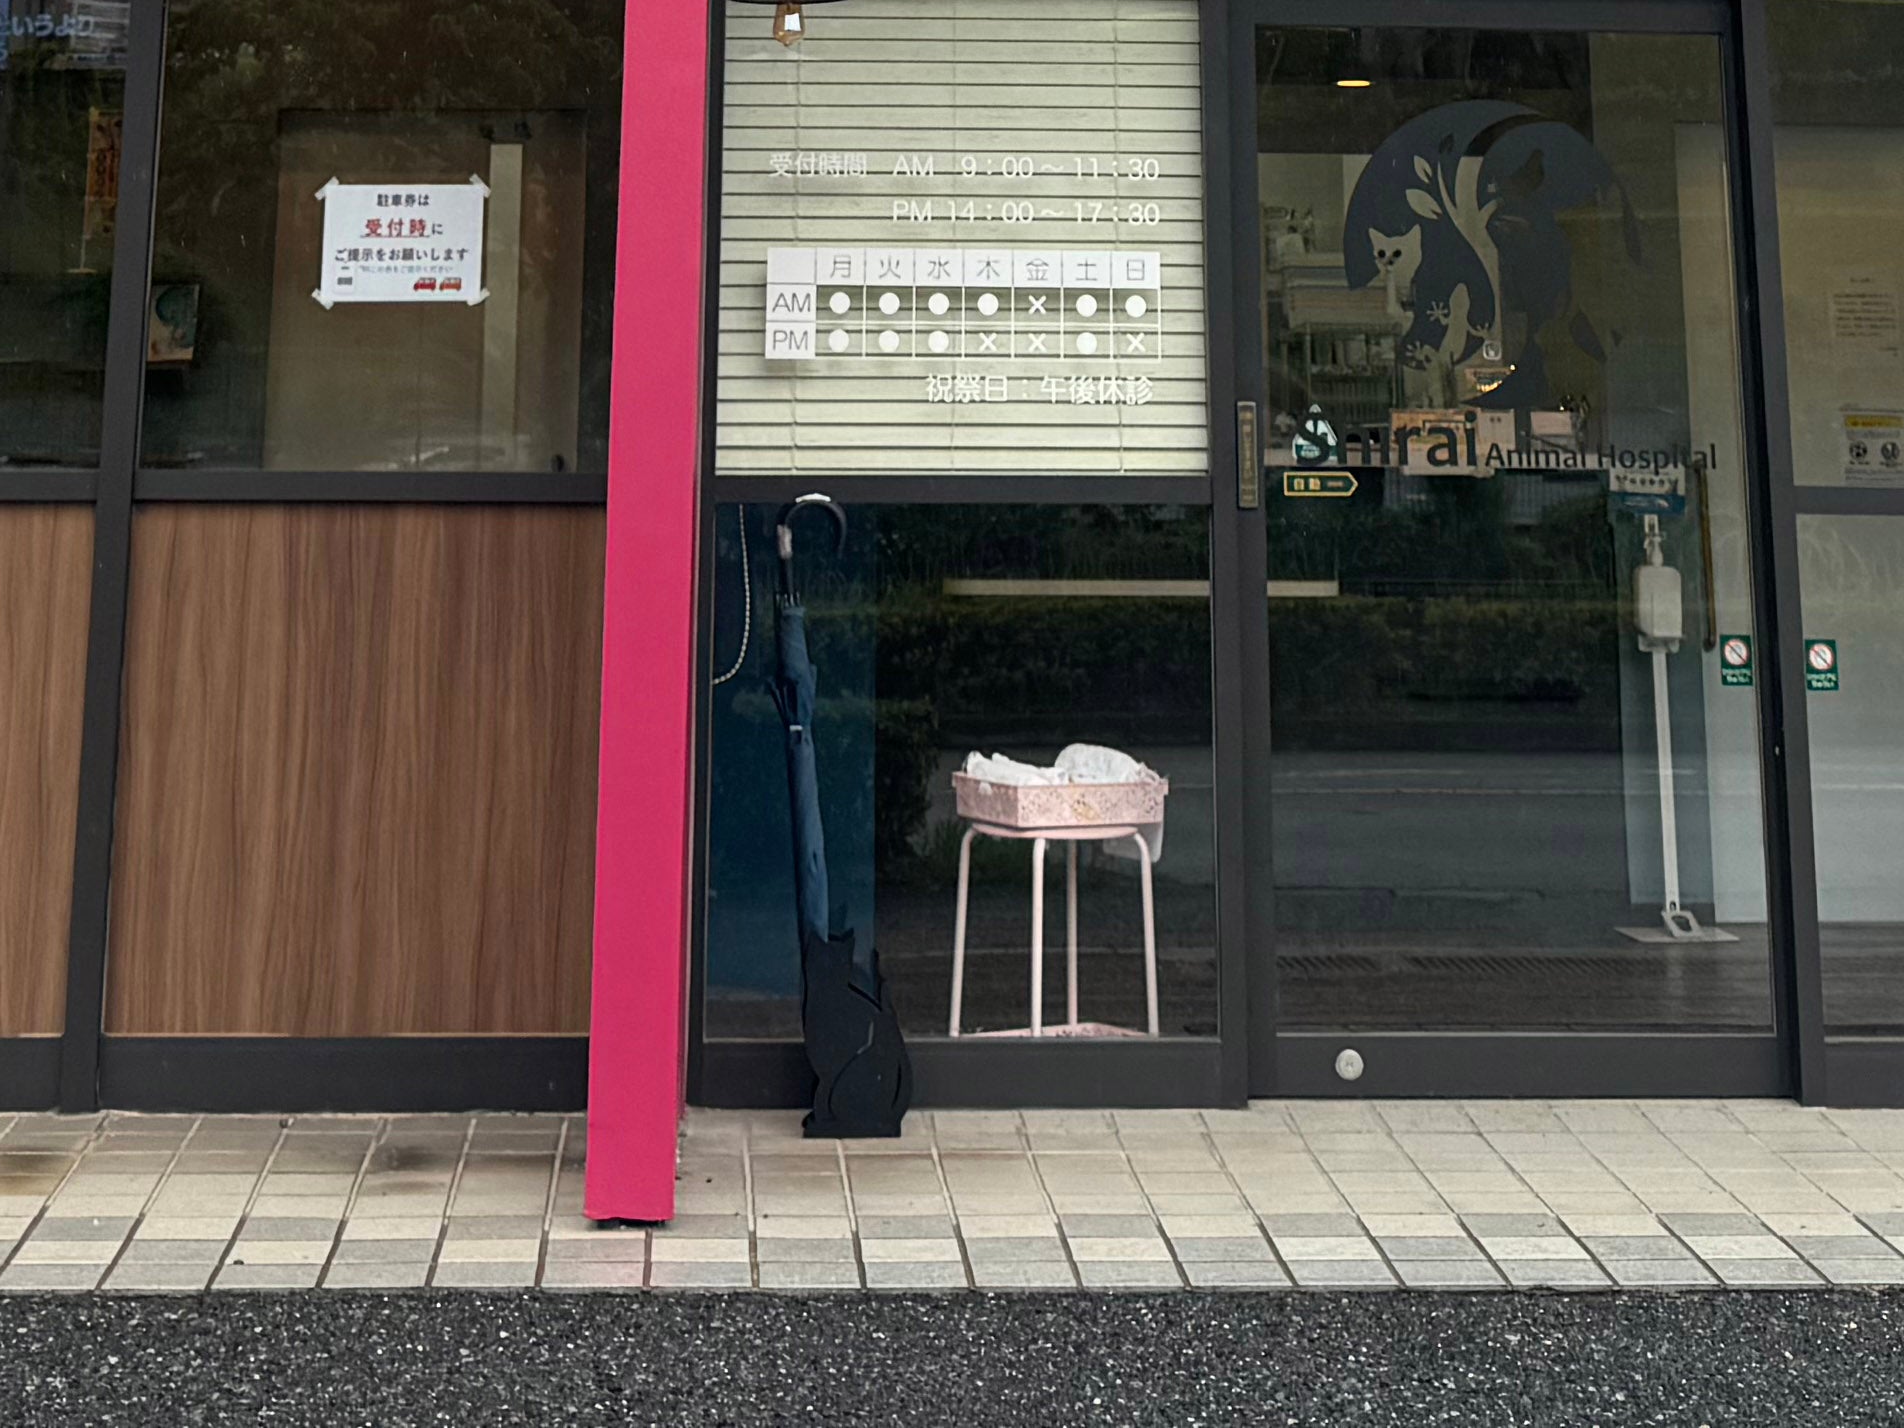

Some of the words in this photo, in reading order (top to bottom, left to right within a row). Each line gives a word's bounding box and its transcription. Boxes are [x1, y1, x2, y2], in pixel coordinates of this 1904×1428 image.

[768, 153, 867, 178] 受付時間
[893, 156, 935, 178] AM
[376, 193, 430, 208] 駐車券は
[892, 201, 933, 223] PM
[364, 217, 444, 237] 受付時に
[829, 255, 852, 279] 月
[878, 256, 901, 280] 火
[927, 256, 951, 280] 水
[976, 257, 1000, 281] 木
[1025, 257, 1049, 281] 金
[1076, 258, 1097, 282] 土
[1126, 259, 1145, 281] 日
[772, 291, 812, 313] AM
[772, 330, 809, 352] PM
[925, 374, 1154, 406] 祝祭日：午後休診
[1296, 410, 1479, 467] Shirai
[1485, 442, 1587, 468] Animal
[1596, 443, 1717, 476] Hospital
